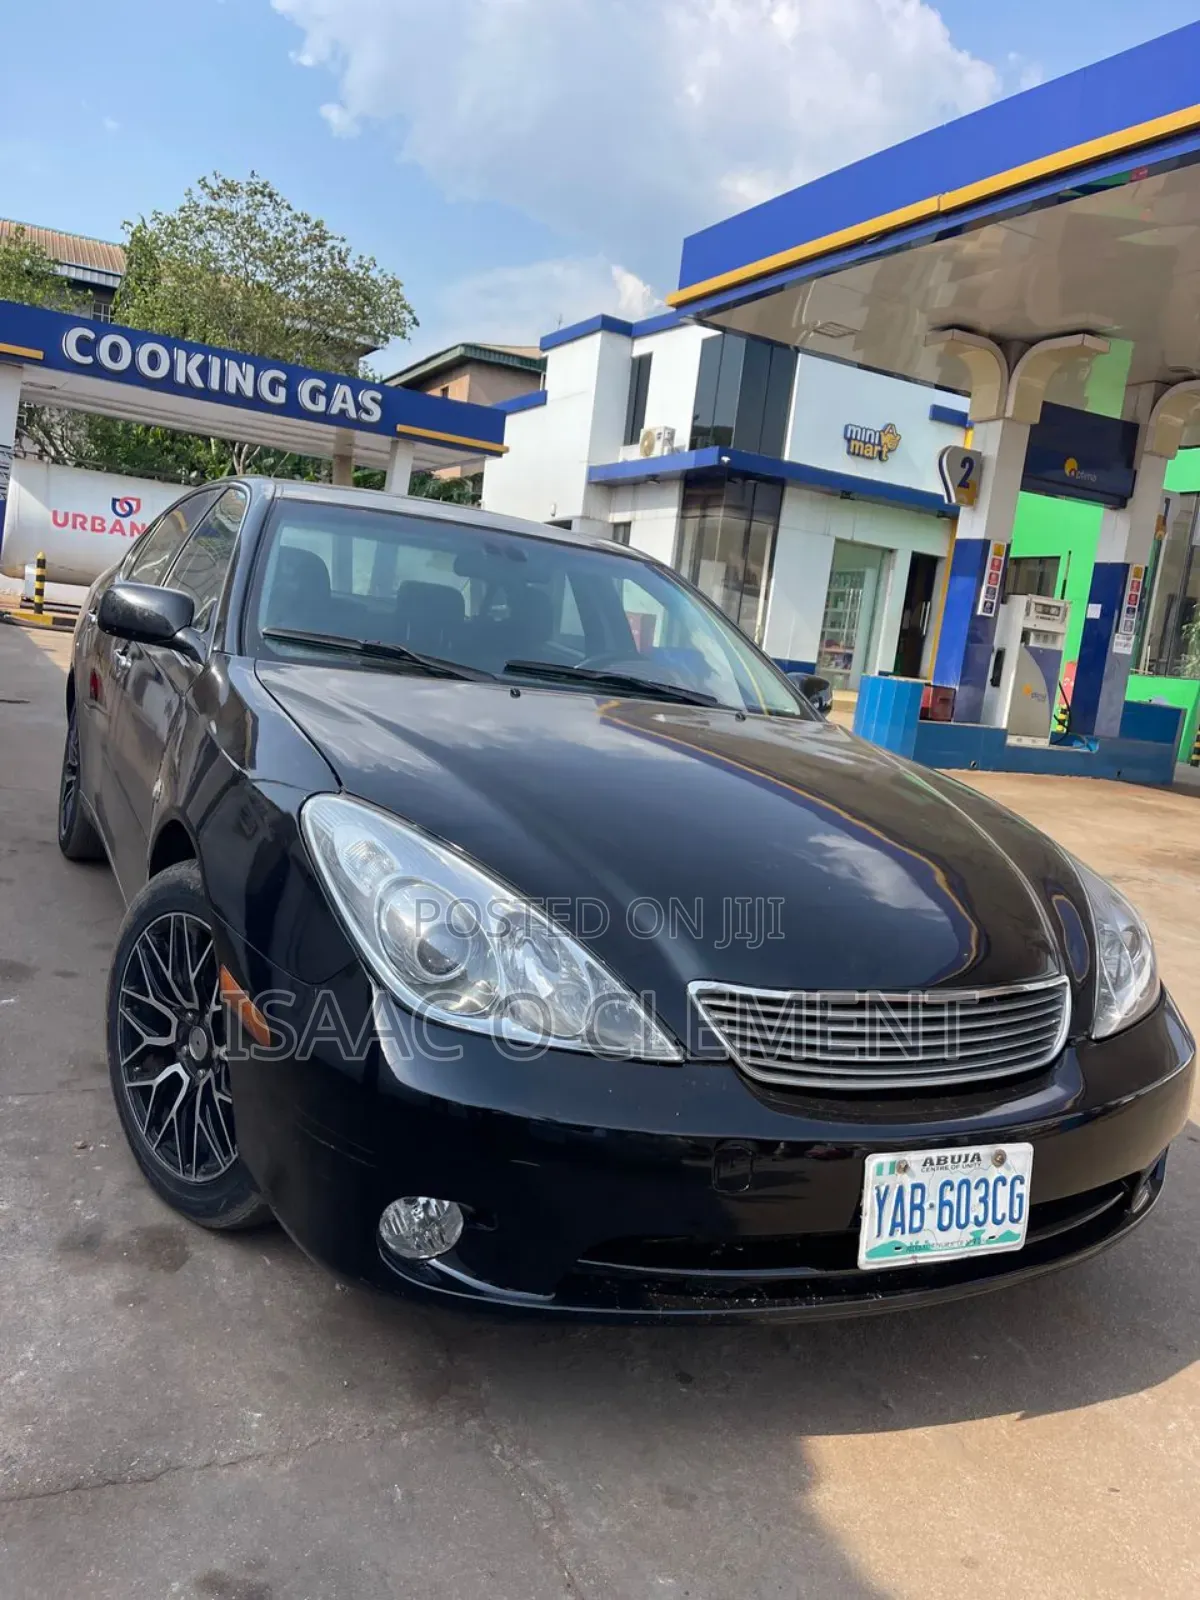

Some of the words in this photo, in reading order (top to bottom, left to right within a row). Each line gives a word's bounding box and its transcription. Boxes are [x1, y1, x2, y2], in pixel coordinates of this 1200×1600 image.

[62, 327, 287, 404] COOKING
[298, 378, 382, 422] GAS
[846, 424, 880, 444] mini
[850, 439, 889, 461] mart
[957, 456, 975, 489] 2
[52, 510, 148, 537] URBAN
[922, 1152, 982, 1167] ABUJA
